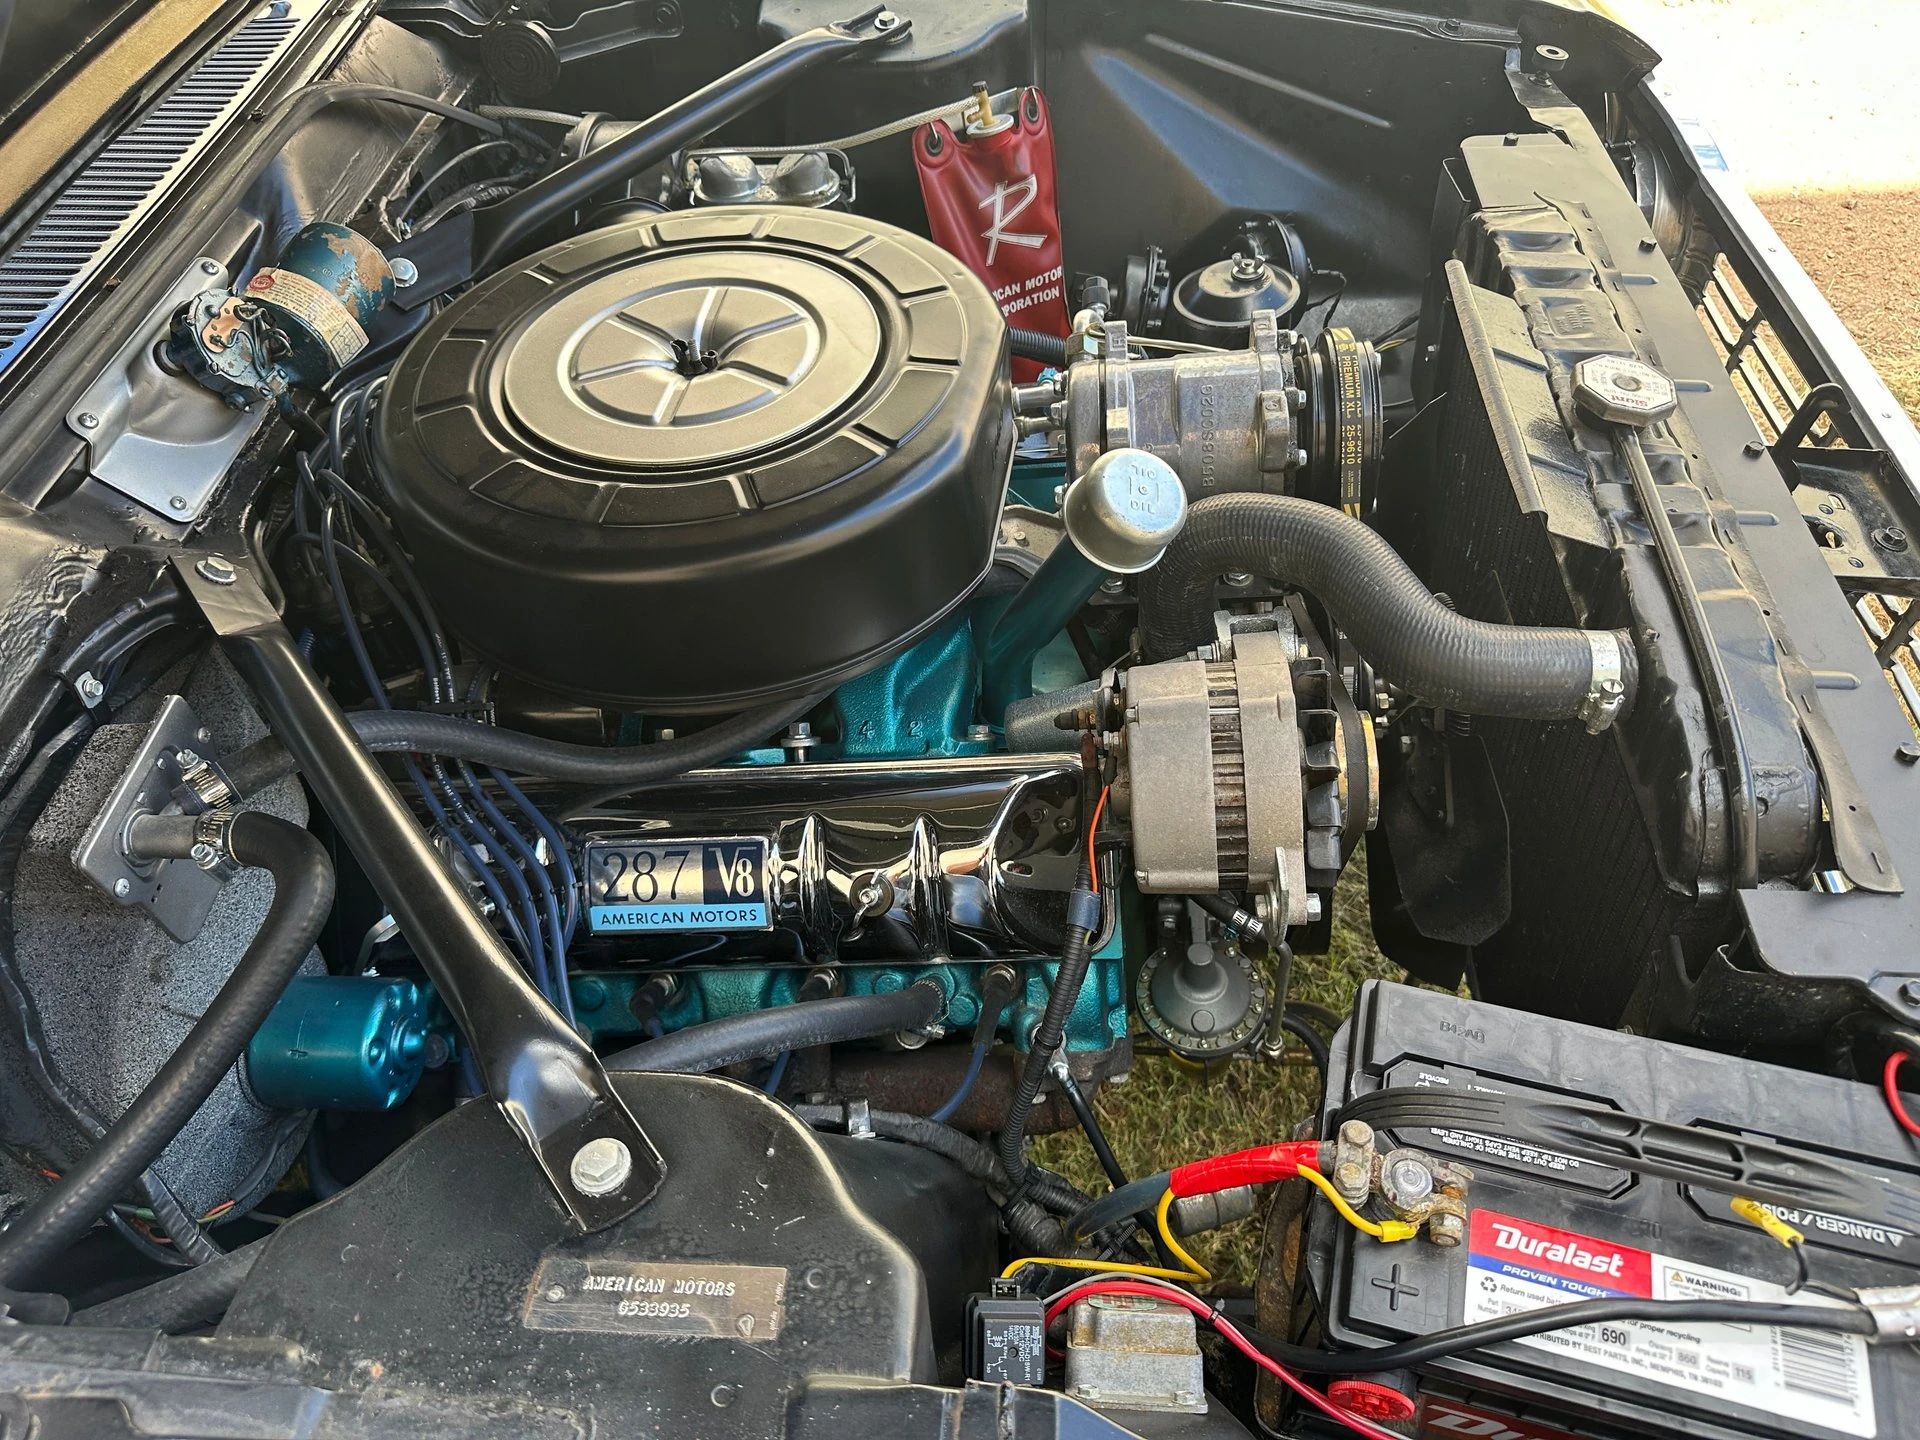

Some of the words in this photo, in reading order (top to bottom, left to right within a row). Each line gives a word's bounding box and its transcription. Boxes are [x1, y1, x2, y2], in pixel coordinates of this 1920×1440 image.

[978, 174, 1047, 266] R
[992, 282, 1021, 302] ICAN
[1342, 355, 1355, 398] PREMIUM
[1346, 424, 1356, 465] 25-9610
[908, 720, 923, 739] 2
[602, 850, 690, 903] 287
[708, 846, 758, 897] V8
[601, 910, 684, 925] AMERICAN
[690, 909, 757, 923] MOTORS
[1418, 1072, 1450, 1085] RECYCLE
[1442, 1136, 1473, 1149] CHILDREN
[1815, 1216, 1885, 1243] DANGER
[1491, 1222, 1624, 1278] Duralast
[583, 1275, 665, 1294] AMERICAN
[673, 1277, 736, 1297] MOTORS
[1502, 1264, 1558, 1286] PROVEN
[1560, 1279, 1606, 1298] TOUGH
[1685, 1275, 1742, 1297] WARNING:
[1500, 1284, 1525, 1298] Return
[1527, 1290, 1544, 1302] used
[1601, 1328, 1627, 1346] 690
[1639, 1322, 1665, 1336] proper
[1666, 1329, 1701, 1344] recycling
[1572, 1341, 1582, 1349] BY
